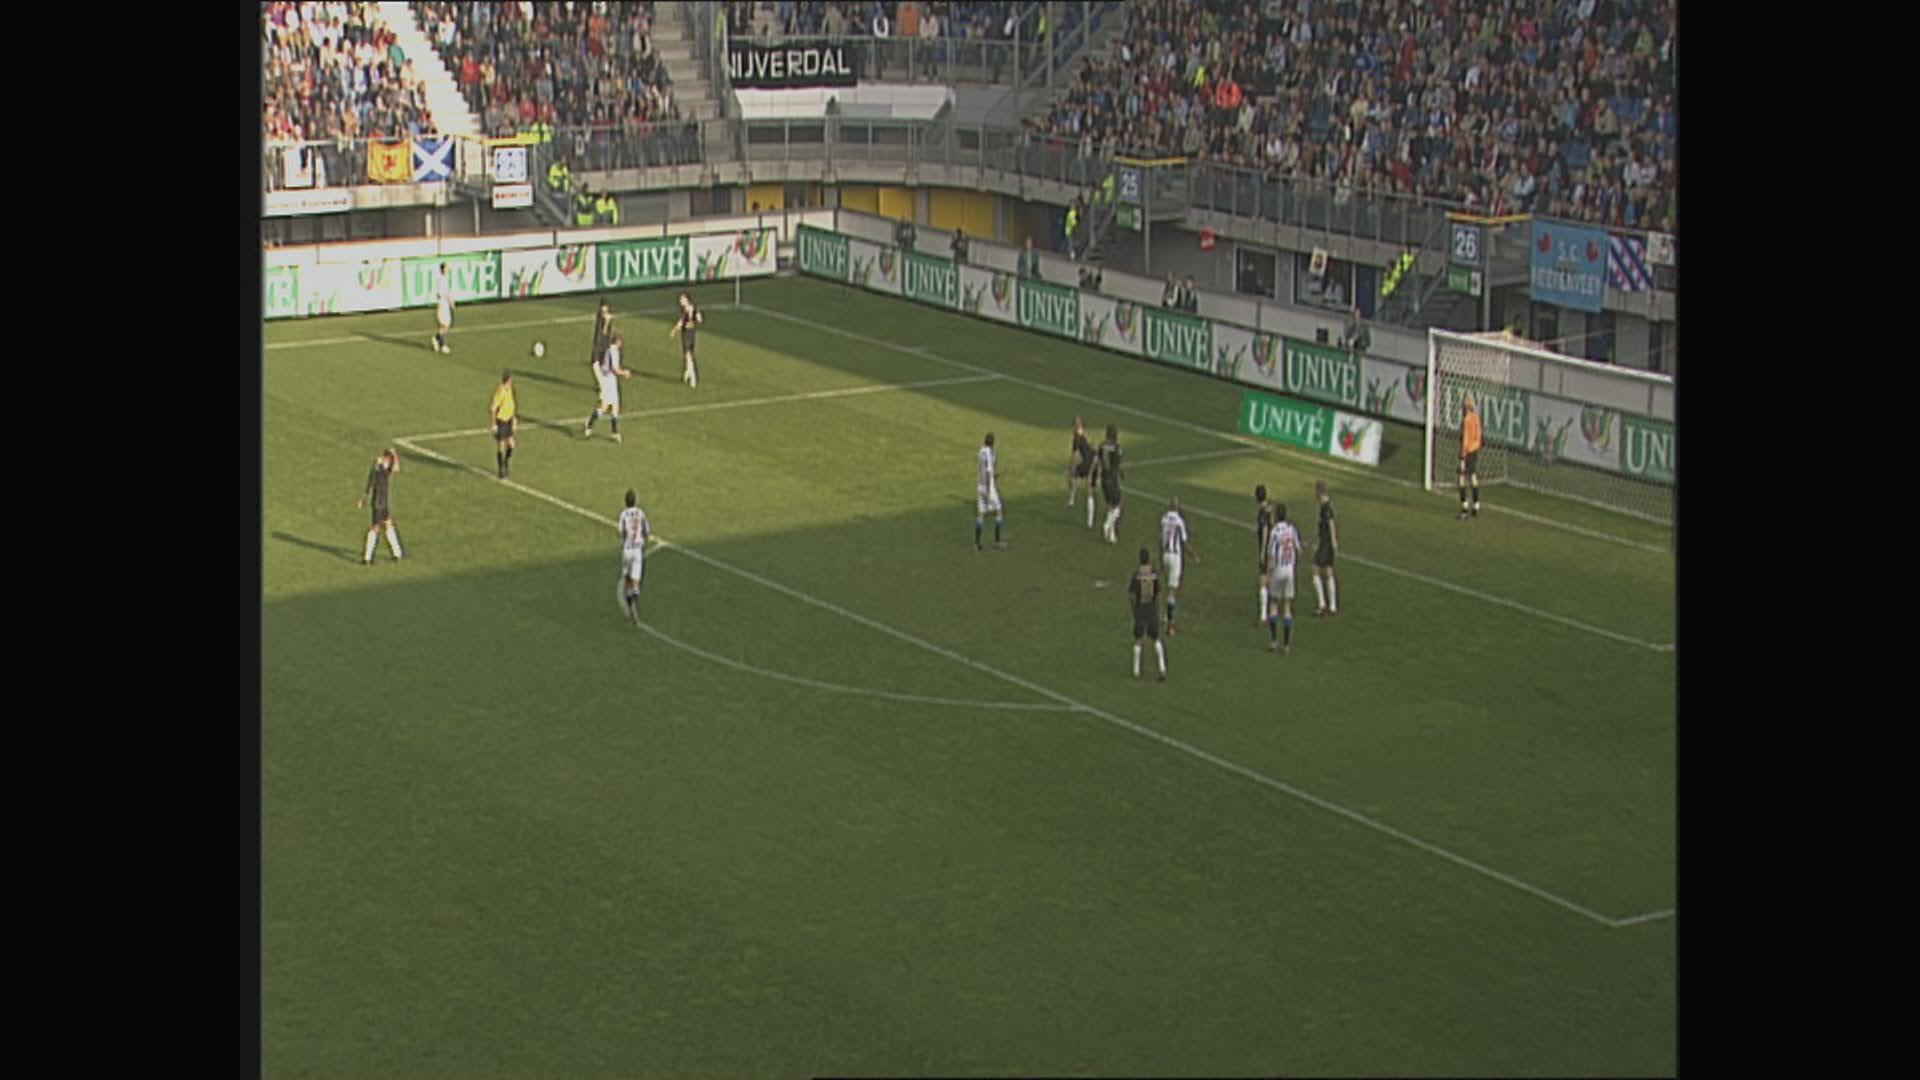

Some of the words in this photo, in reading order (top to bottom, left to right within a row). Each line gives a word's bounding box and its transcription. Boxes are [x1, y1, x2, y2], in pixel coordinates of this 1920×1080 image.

[600, 238, 687, 287] UNIVÉ
[1456, 231, 1477, 258] 26
[904, 258, 960, 307] UNIVÉ
[1020, 286, 1078, 337] UNIVÉ
[1146, 315, 1211, 370] UNIVÉ
[1286, 348, 1358, 402] UNIVÉ
[1249, 402, 1326, 450] UNIVÉ
